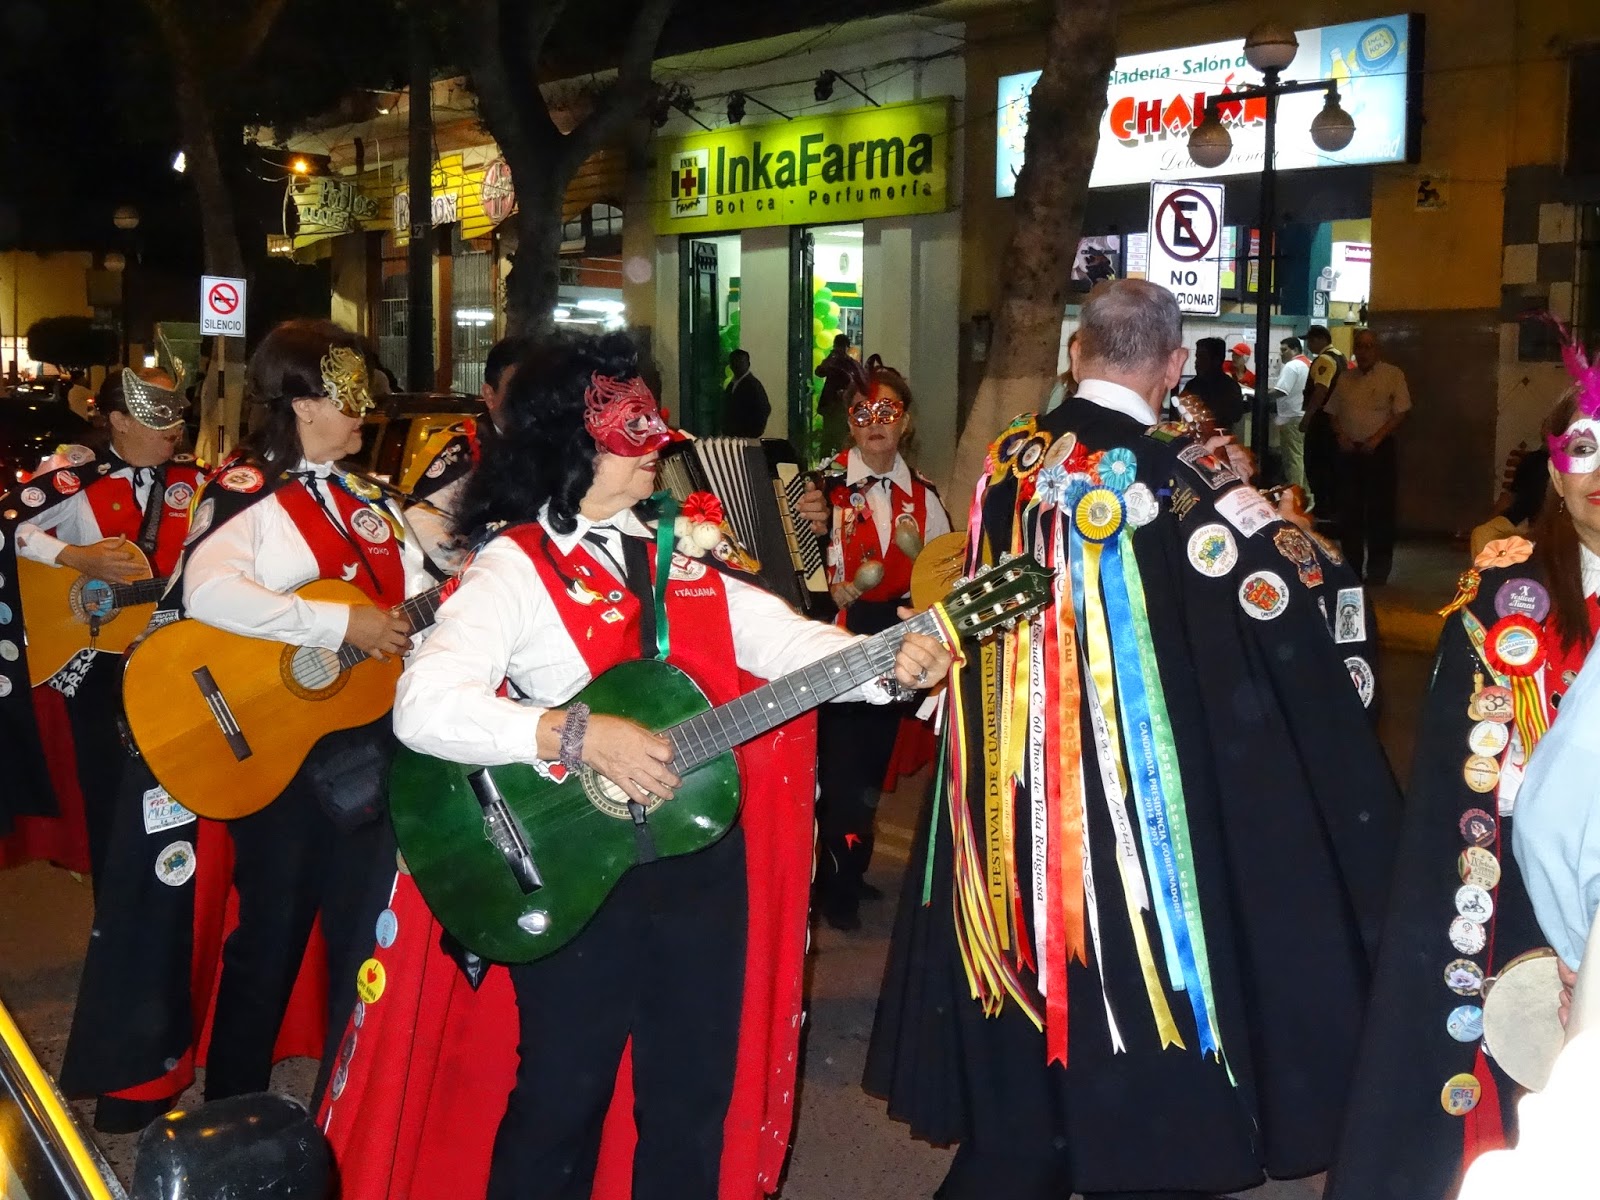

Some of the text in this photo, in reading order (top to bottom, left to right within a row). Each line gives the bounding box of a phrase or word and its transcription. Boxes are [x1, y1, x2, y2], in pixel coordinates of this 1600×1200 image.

[1108, 55, 1247, 86] eladería Salón d
[716, 133, 933, 195] InkaFarma
[715, 197, 775, 215] Botca
[1170, 271, 1198, 286] NO
[1315, 292, 1323, 305] S
[204, 319, 242, 331] SILENCIO
[674, 587, 716, 597] ITALIANA
[1510, 593, 1536, 603] Festival
[1519, 585, 1530, 596] X
[1513, 600, 1535, 610] Tunas
[1033, 621, 1045, 901] Escudero C. 60 Años de Vida Religiosa
[990, 771, 999, 796] DE
[1139, 721, 1156, 777] CANDIDATA
[1150, 778, 1165, 845] PRESIDENCIA
[1161, 845, 1183, 921] GOBERNADORES
[990, 802, 1004, 887] FESTIVAL
